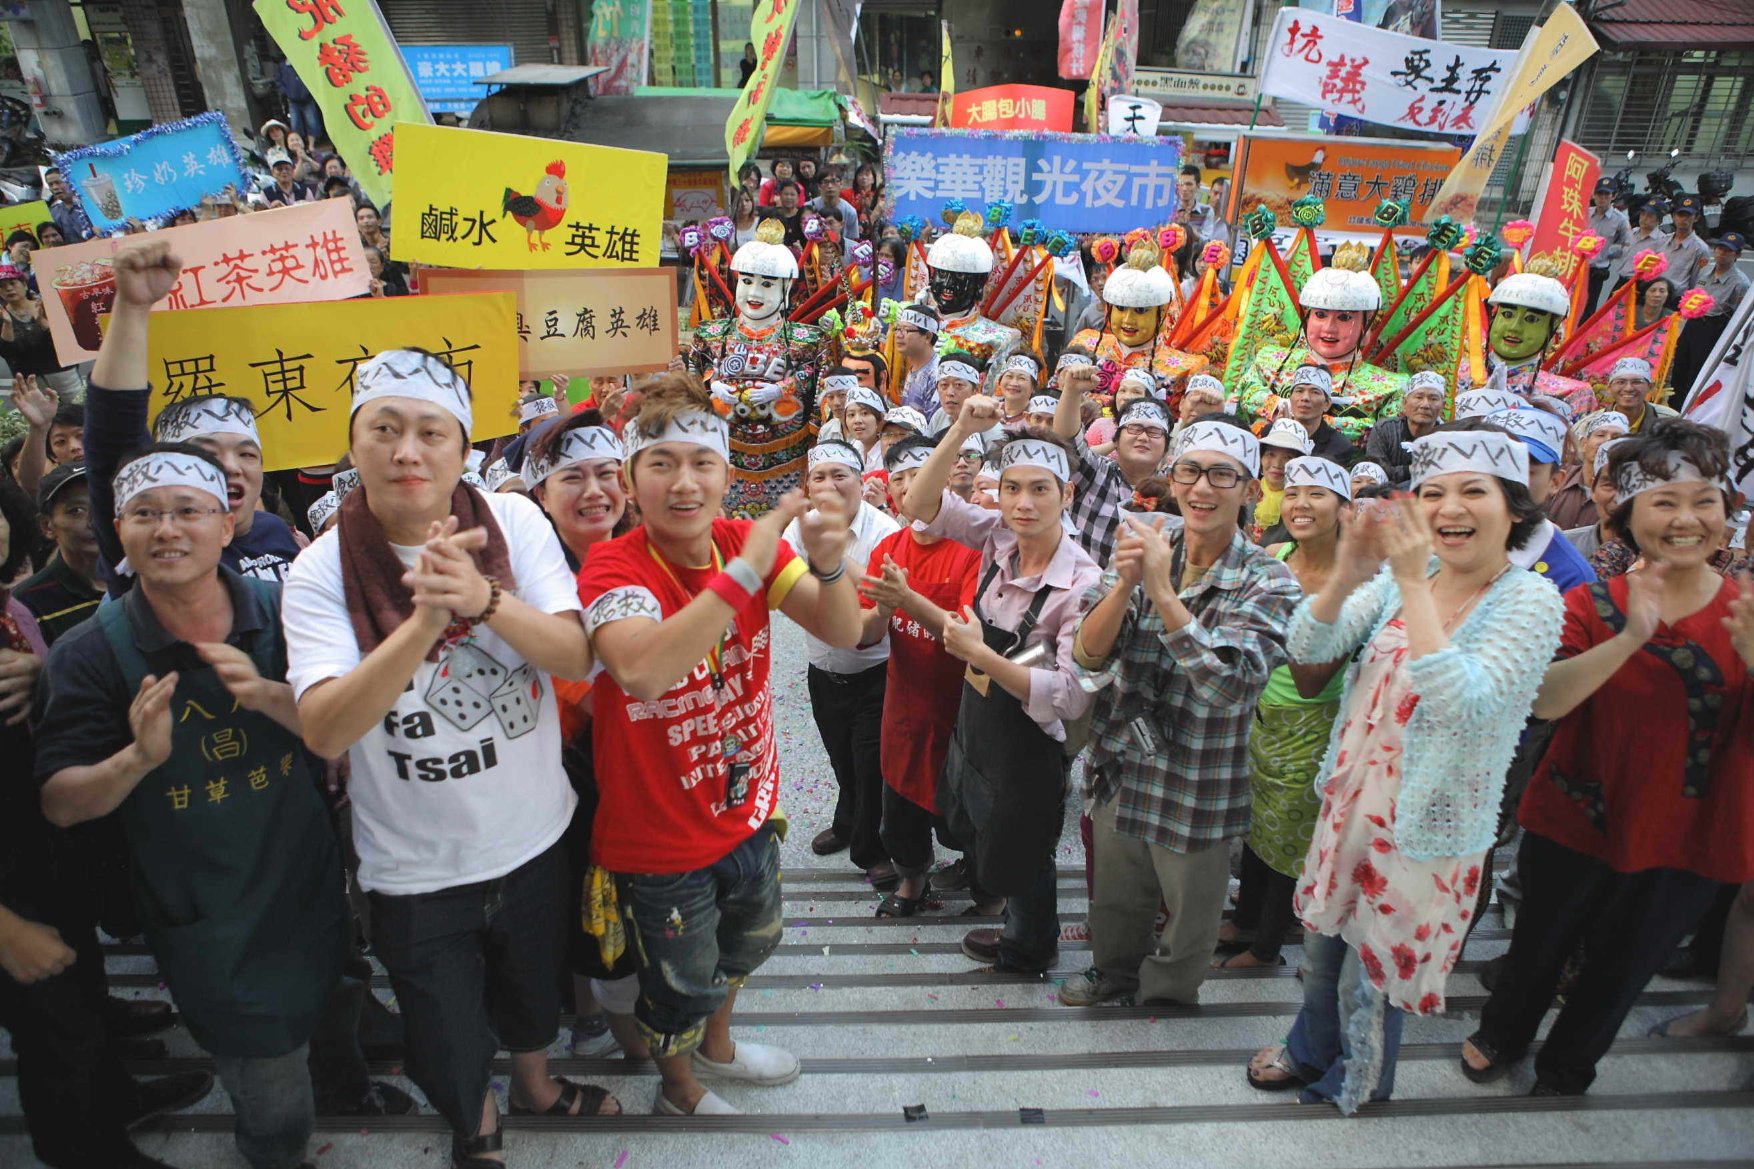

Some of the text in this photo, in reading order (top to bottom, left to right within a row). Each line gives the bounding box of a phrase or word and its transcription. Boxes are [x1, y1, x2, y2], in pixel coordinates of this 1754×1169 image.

[1281, 19, 1370, 115] 抗議
[123, 144, 233, 194] 珍奶英雄
[892, 151, 1177, 209] 樂華觀光夜市
[420, 203, 641, 263] 鹹水 英雄
[387, 737, 498, 782] Tsai
